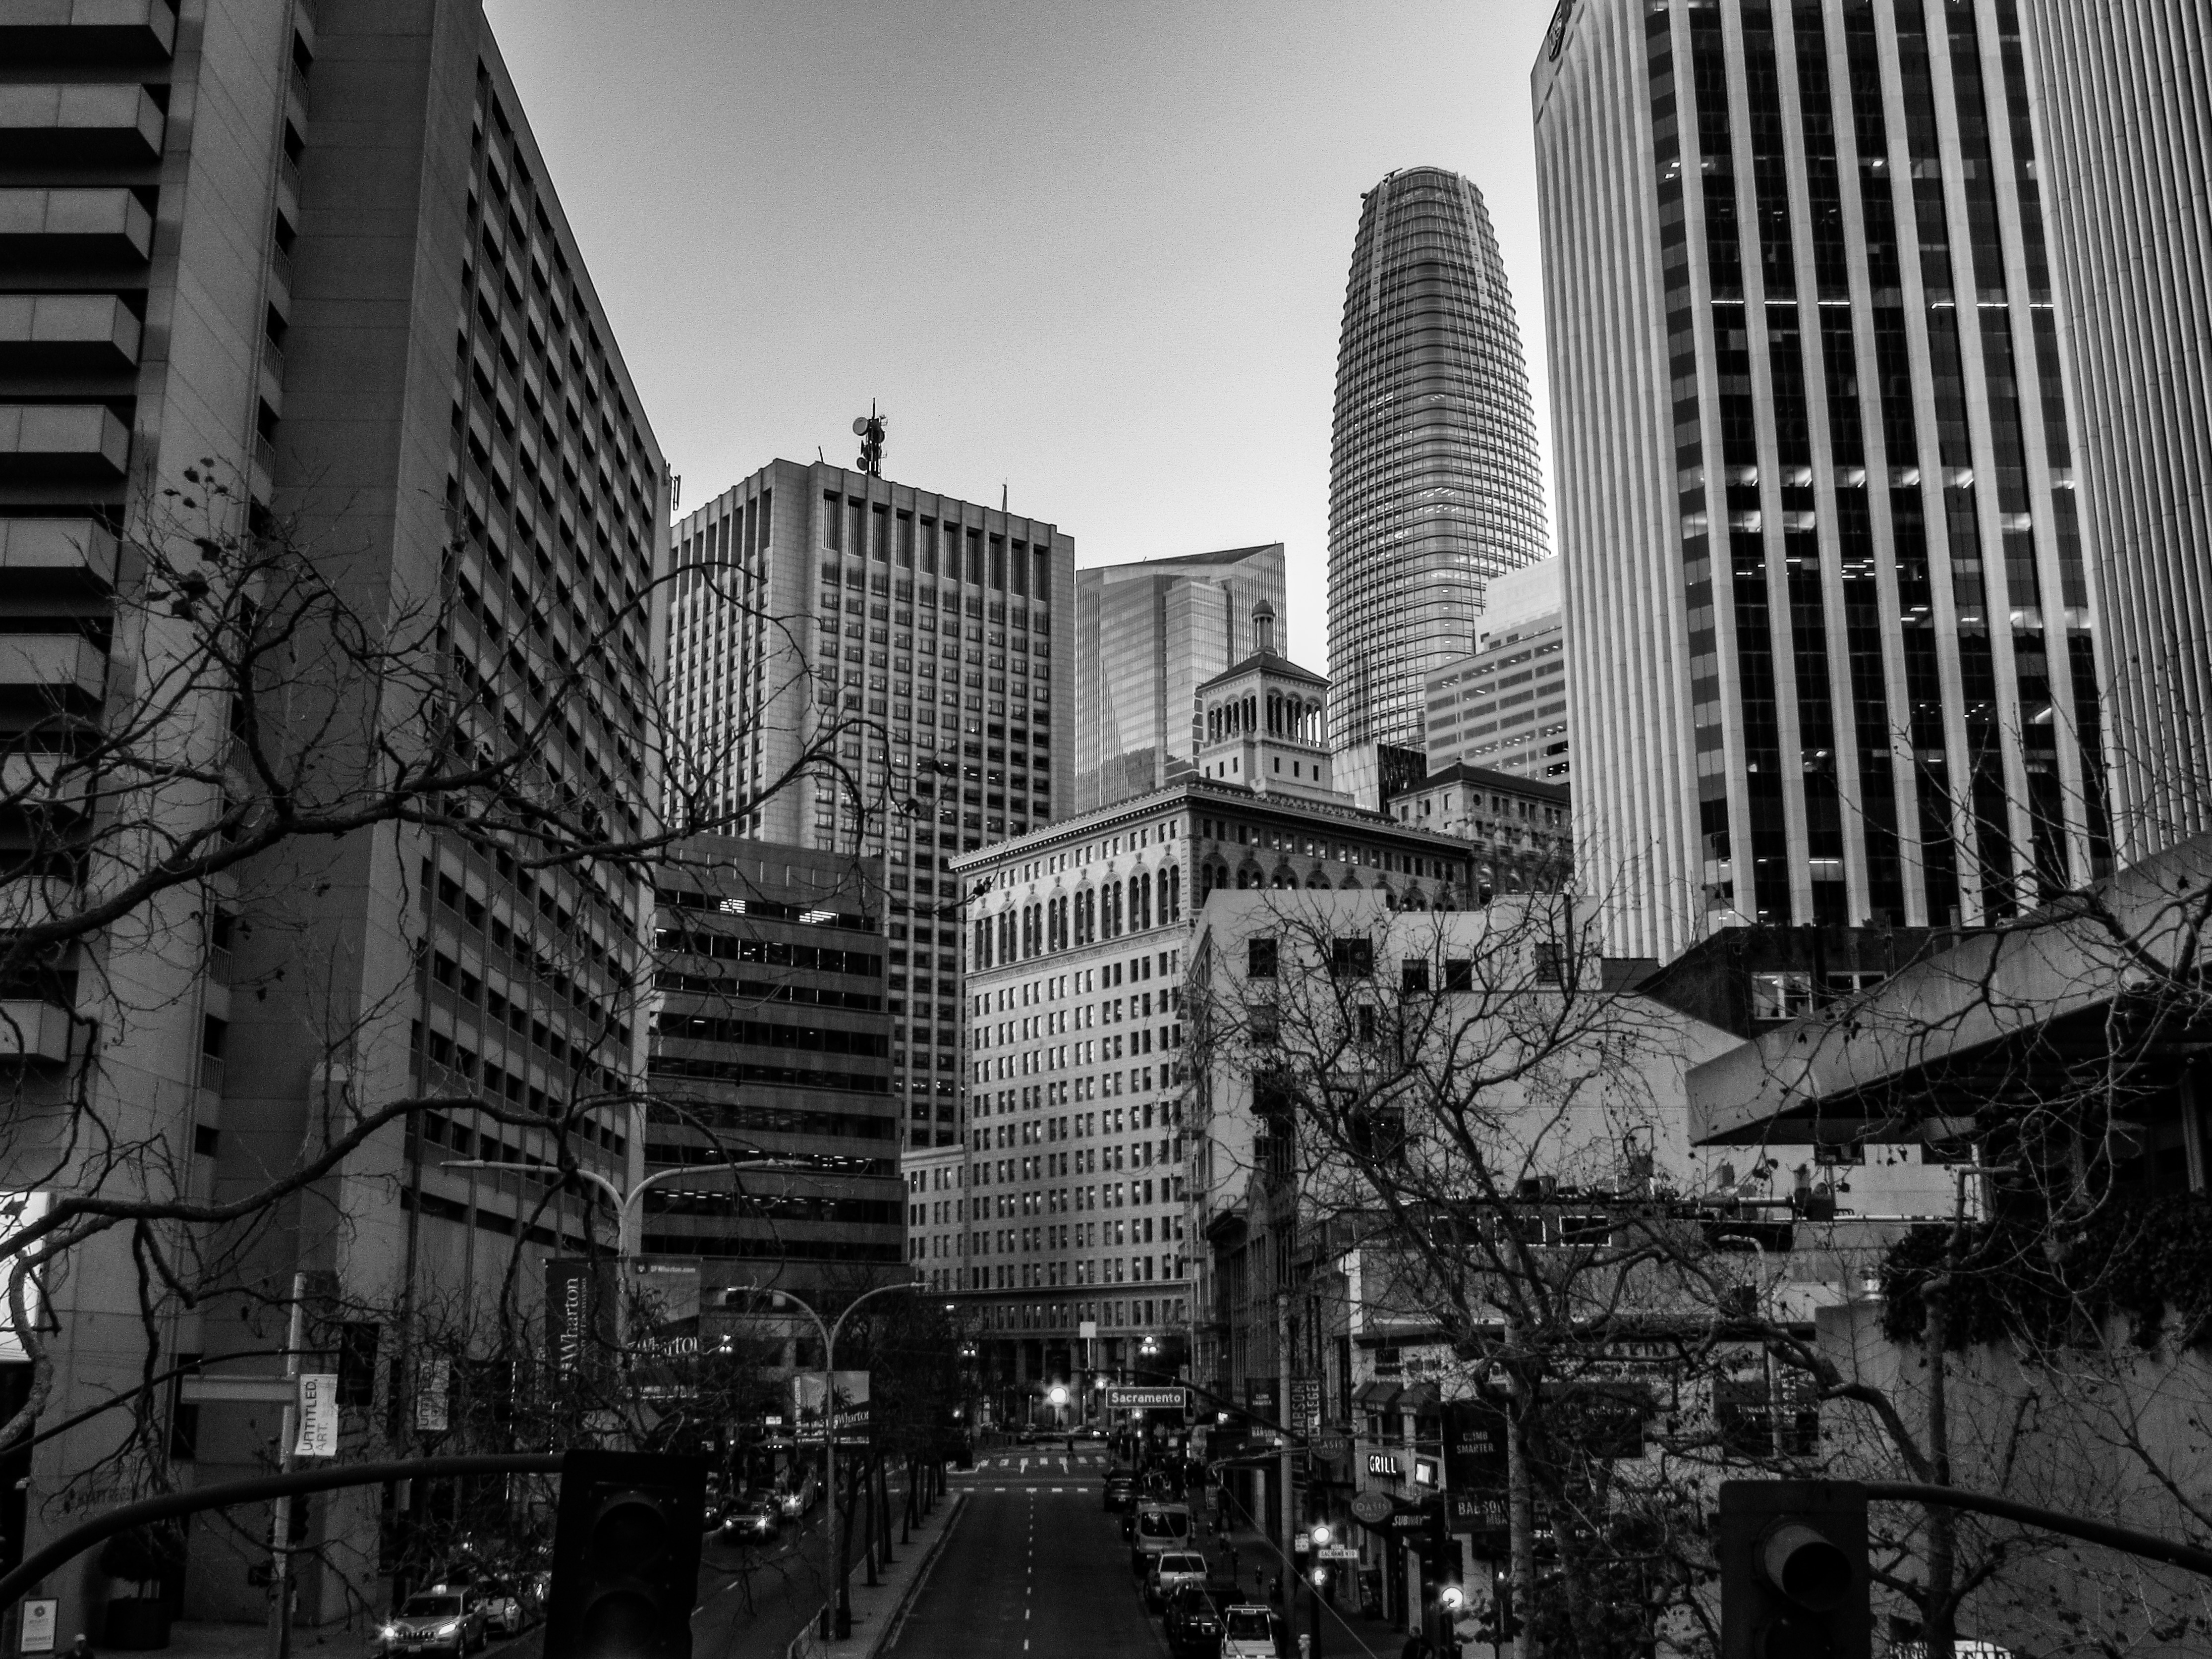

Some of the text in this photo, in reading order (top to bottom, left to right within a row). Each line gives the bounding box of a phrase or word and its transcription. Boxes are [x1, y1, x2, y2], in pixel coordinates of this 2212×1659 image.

[560, 1277, 579, 1362] Wharton
[1111, 1392, 1181, 1403] Sacramento
[1315, 1438, 1344, 1449] ASIS
[1369, 1455, 1397, 1474] GRILL
